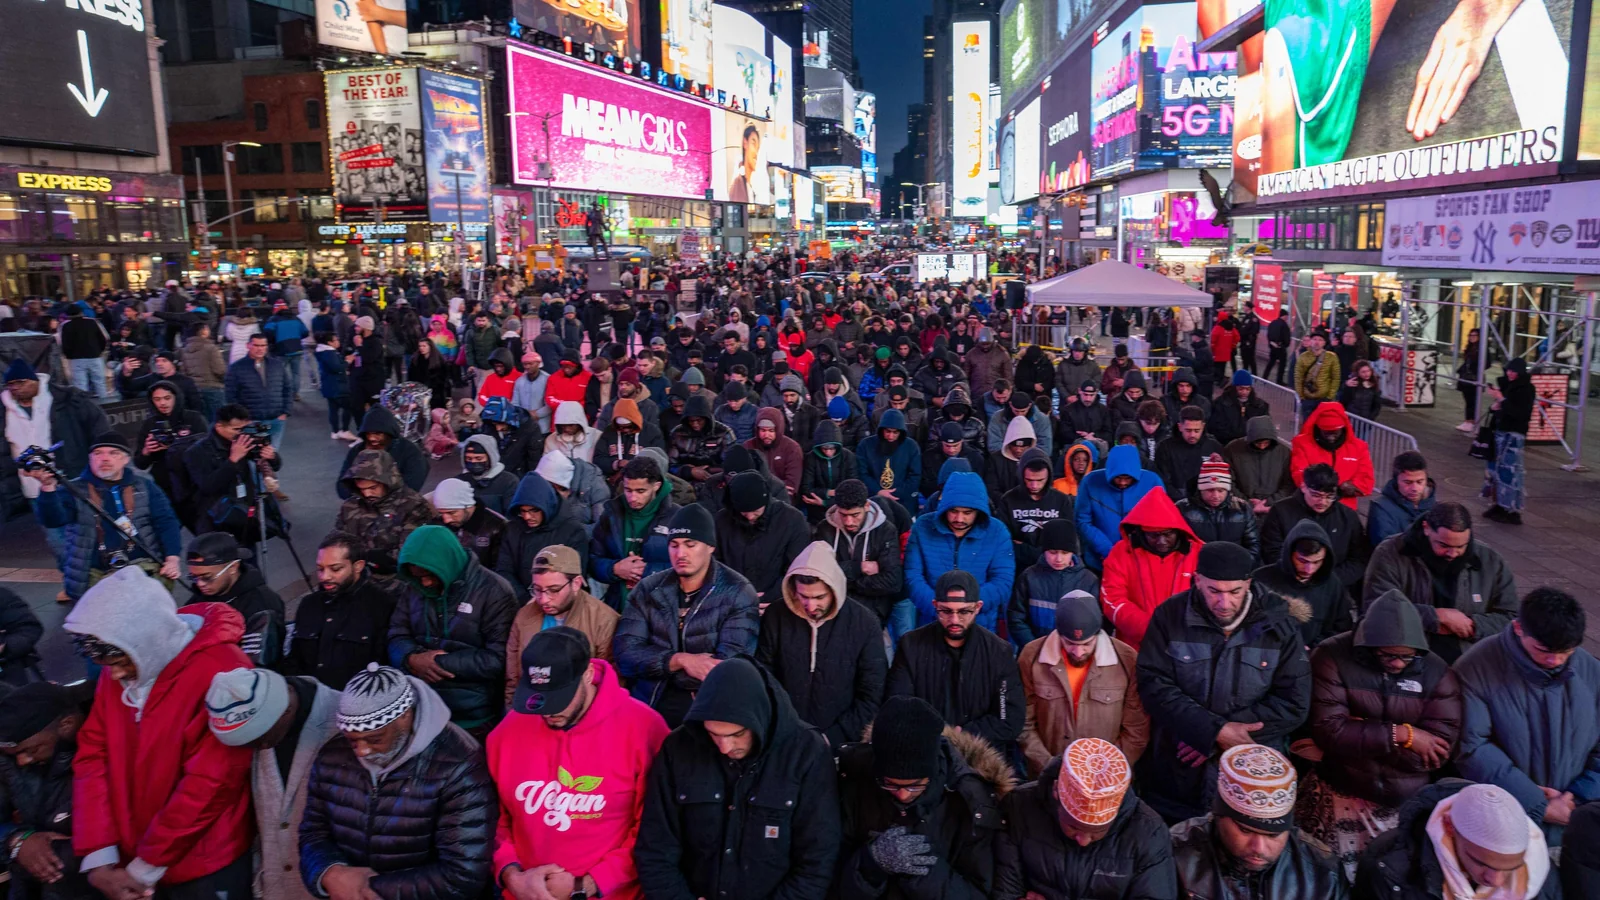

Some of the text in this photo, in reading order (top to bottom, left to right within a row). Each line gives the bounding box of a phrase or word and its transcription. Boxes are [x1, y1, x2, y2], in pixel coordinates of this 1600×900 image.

[342, 86, 409, 101] THE YEAR!
[348, 72, 402, 87] BEST OF
[561, 93, 641, 149] MEAN
[1048, 112, 1079, 147] SEPHORA
[1161, 104, 1210, 137] 5G
[1257, 125, 1558, 197] AMERICAN EAGLE OUTFITTERS
[17, 172, 112, 192] EXPRESS
[1436, 189, 1552, 218] SPORTS FAN SHOP
[318, 224, 407, 235] GIFTS LUGGAGE
[1404, 350, 1416, 403] CHICAGO
[1012, 508, 1060, 519] Reebok
[514, 780, 607, 832] Vegan
